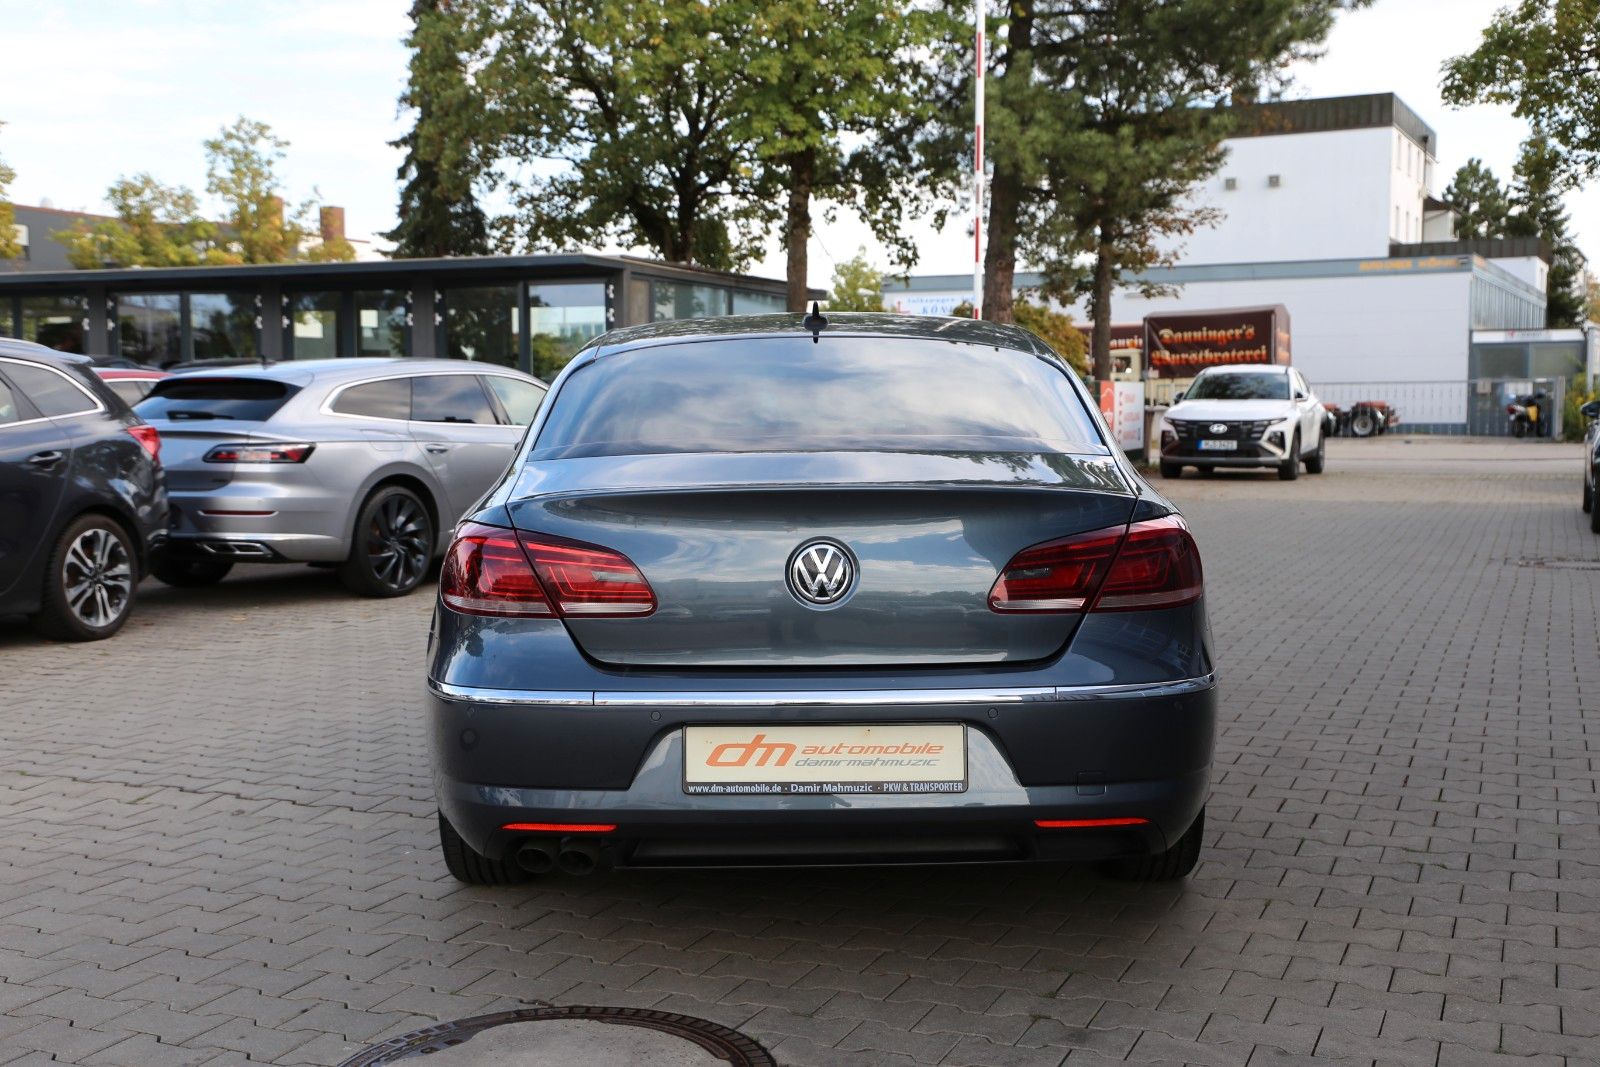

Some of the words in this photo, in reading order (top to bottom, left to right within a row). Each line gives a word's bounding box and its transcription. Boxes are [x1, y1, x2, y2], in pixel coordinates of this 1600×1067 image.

[705, 734, 797, 767] dm
[801, 742, 944, 755] automobile
[688, 783, 782, 793] www.dm-automobile.de
[790, 783, 821, 792] Damir
[822, 783, 873, 792] Mahmuzic
[883, 783, 900, 791] PKW
[902, 783, 909, 791] &
[910, 782, 963, 791] TRANSPORTER
